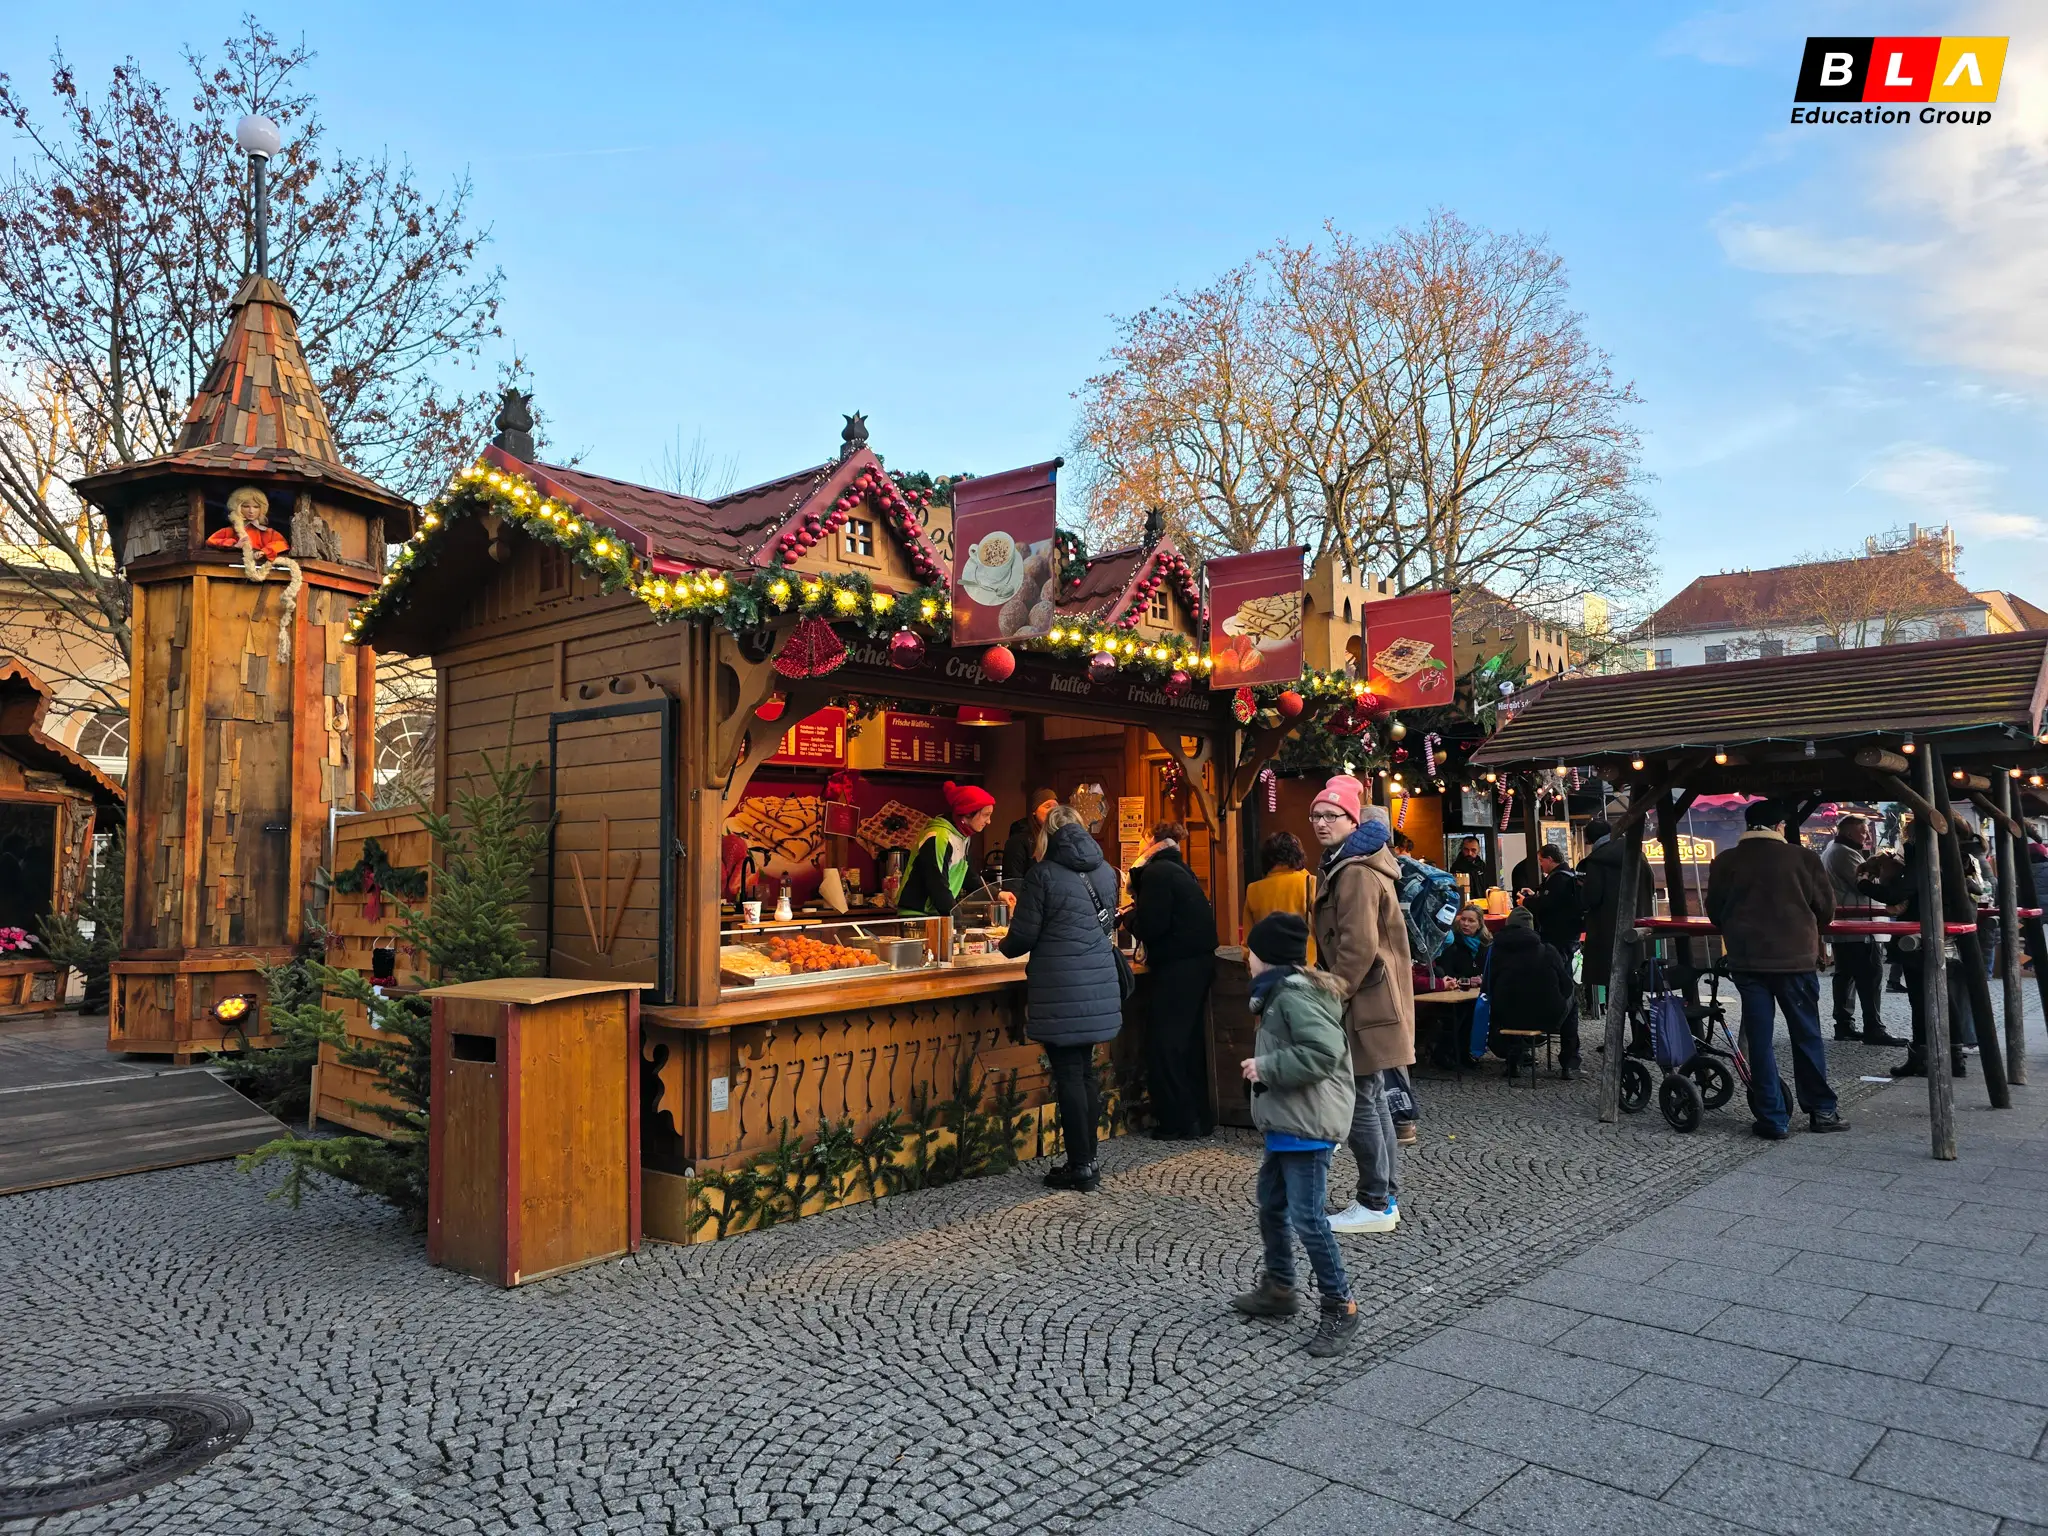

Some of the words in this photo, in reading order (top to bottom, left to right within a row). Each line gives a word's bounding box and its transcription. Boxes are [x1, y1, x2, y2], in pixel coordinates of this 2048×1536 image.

[946, 656, 1006, 685] Crêp
[1050, 673, 1091, 695] Kaffee
[1128, 685, 1167, 706] Frische
[892, 718, 911, 727] Frische
[911, 720, 930, 729] Waffeln
